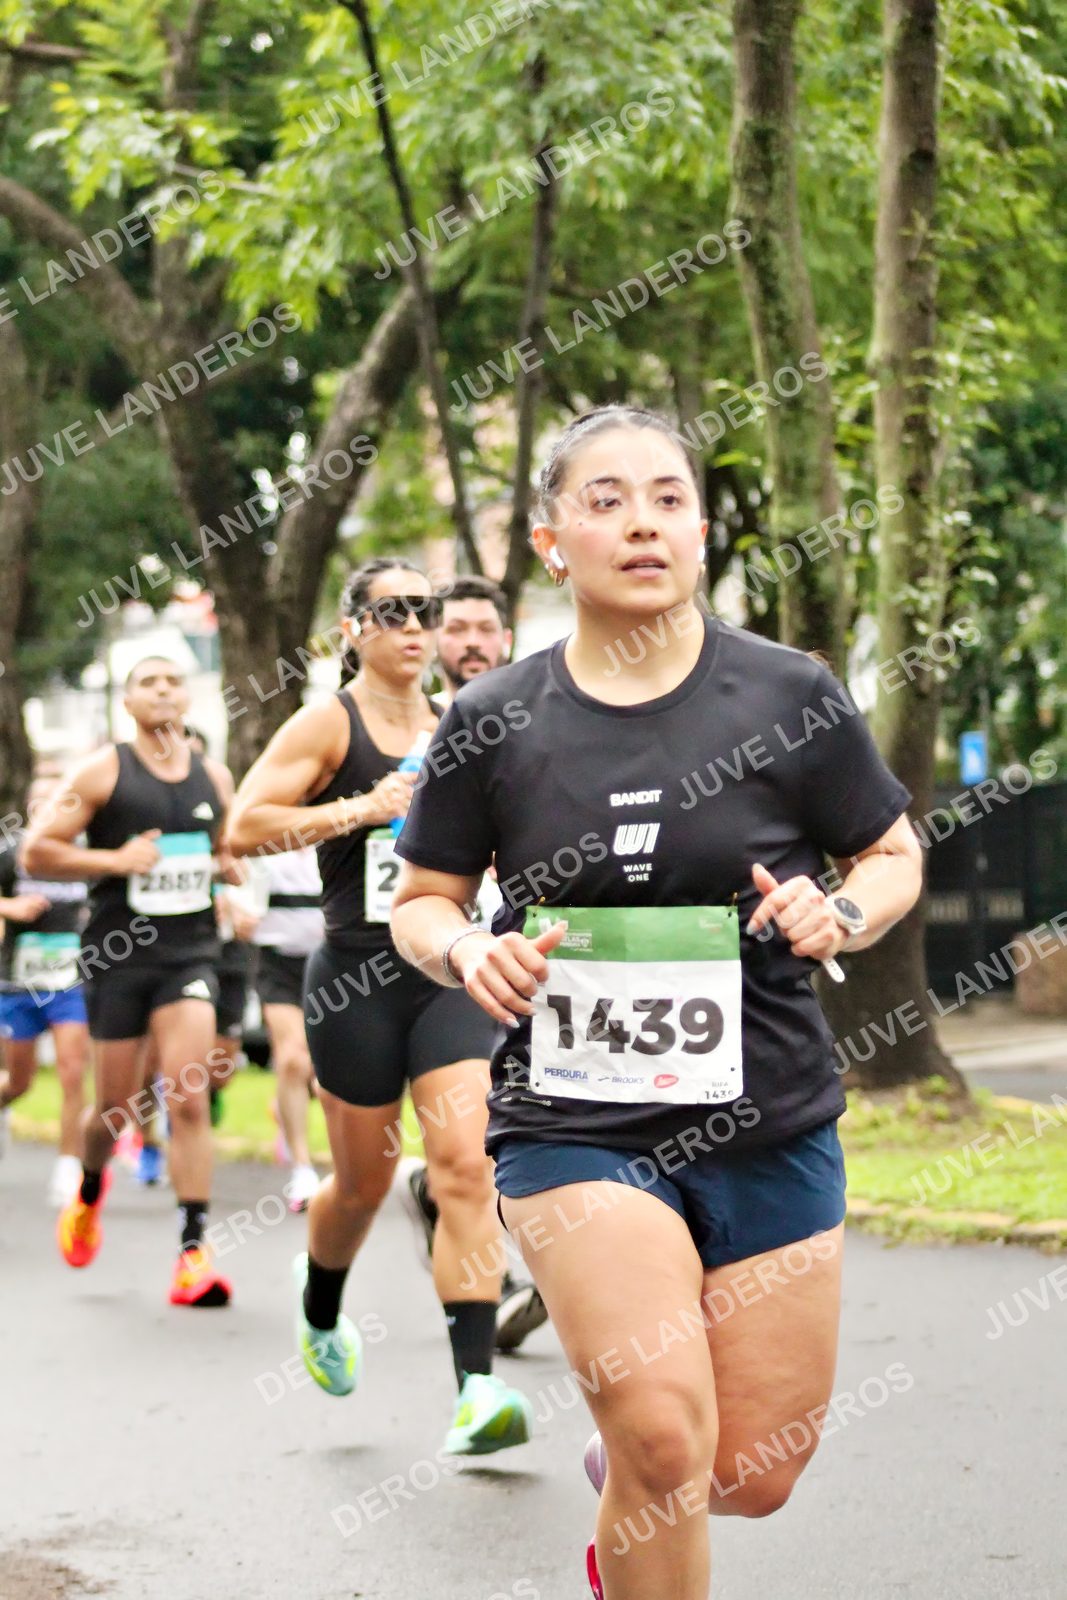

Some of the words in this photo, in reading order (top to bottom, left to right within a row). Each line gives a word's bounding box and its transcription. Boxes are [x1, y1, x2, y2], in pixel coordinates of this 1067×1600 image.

[610, 790, 662, 807] BANDIT
[623, 863, 653, 873] WAVE
[139, 870, 206, 892] 2887
[628, 873, 650, 882] ONE
[547, 994, 724, 1056] 1439
[544, 1067, 589, 1079] PERDURA
[611, 1076, 645, 1084] BROOKS
